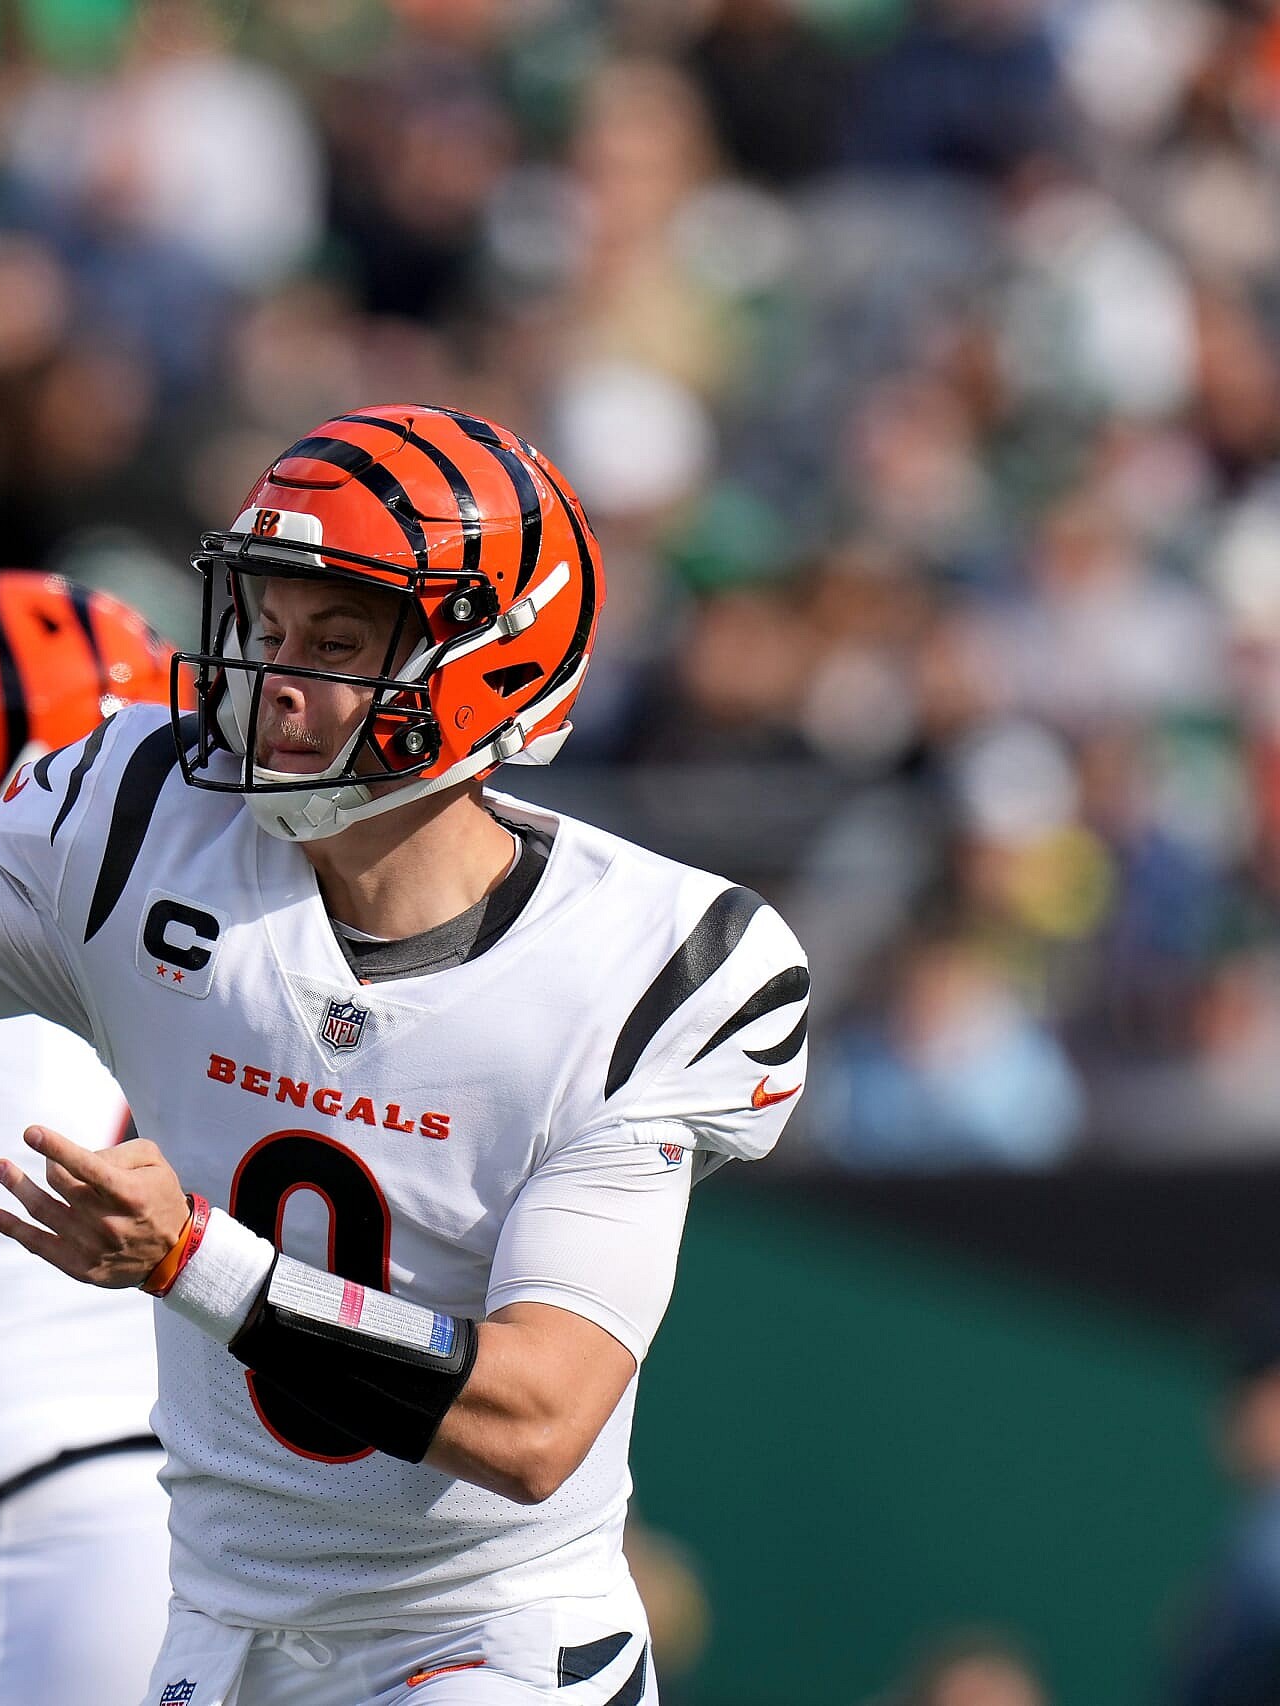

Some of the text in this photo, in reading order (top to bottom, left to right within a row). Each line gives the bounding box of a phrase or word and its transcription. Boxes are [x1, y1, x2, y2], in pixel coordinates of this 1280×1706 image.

[143, 899, 220, 972] C
[324, 1018, 356, 1044] NFL
[207, 1053, 451, 1141] BENGALS
